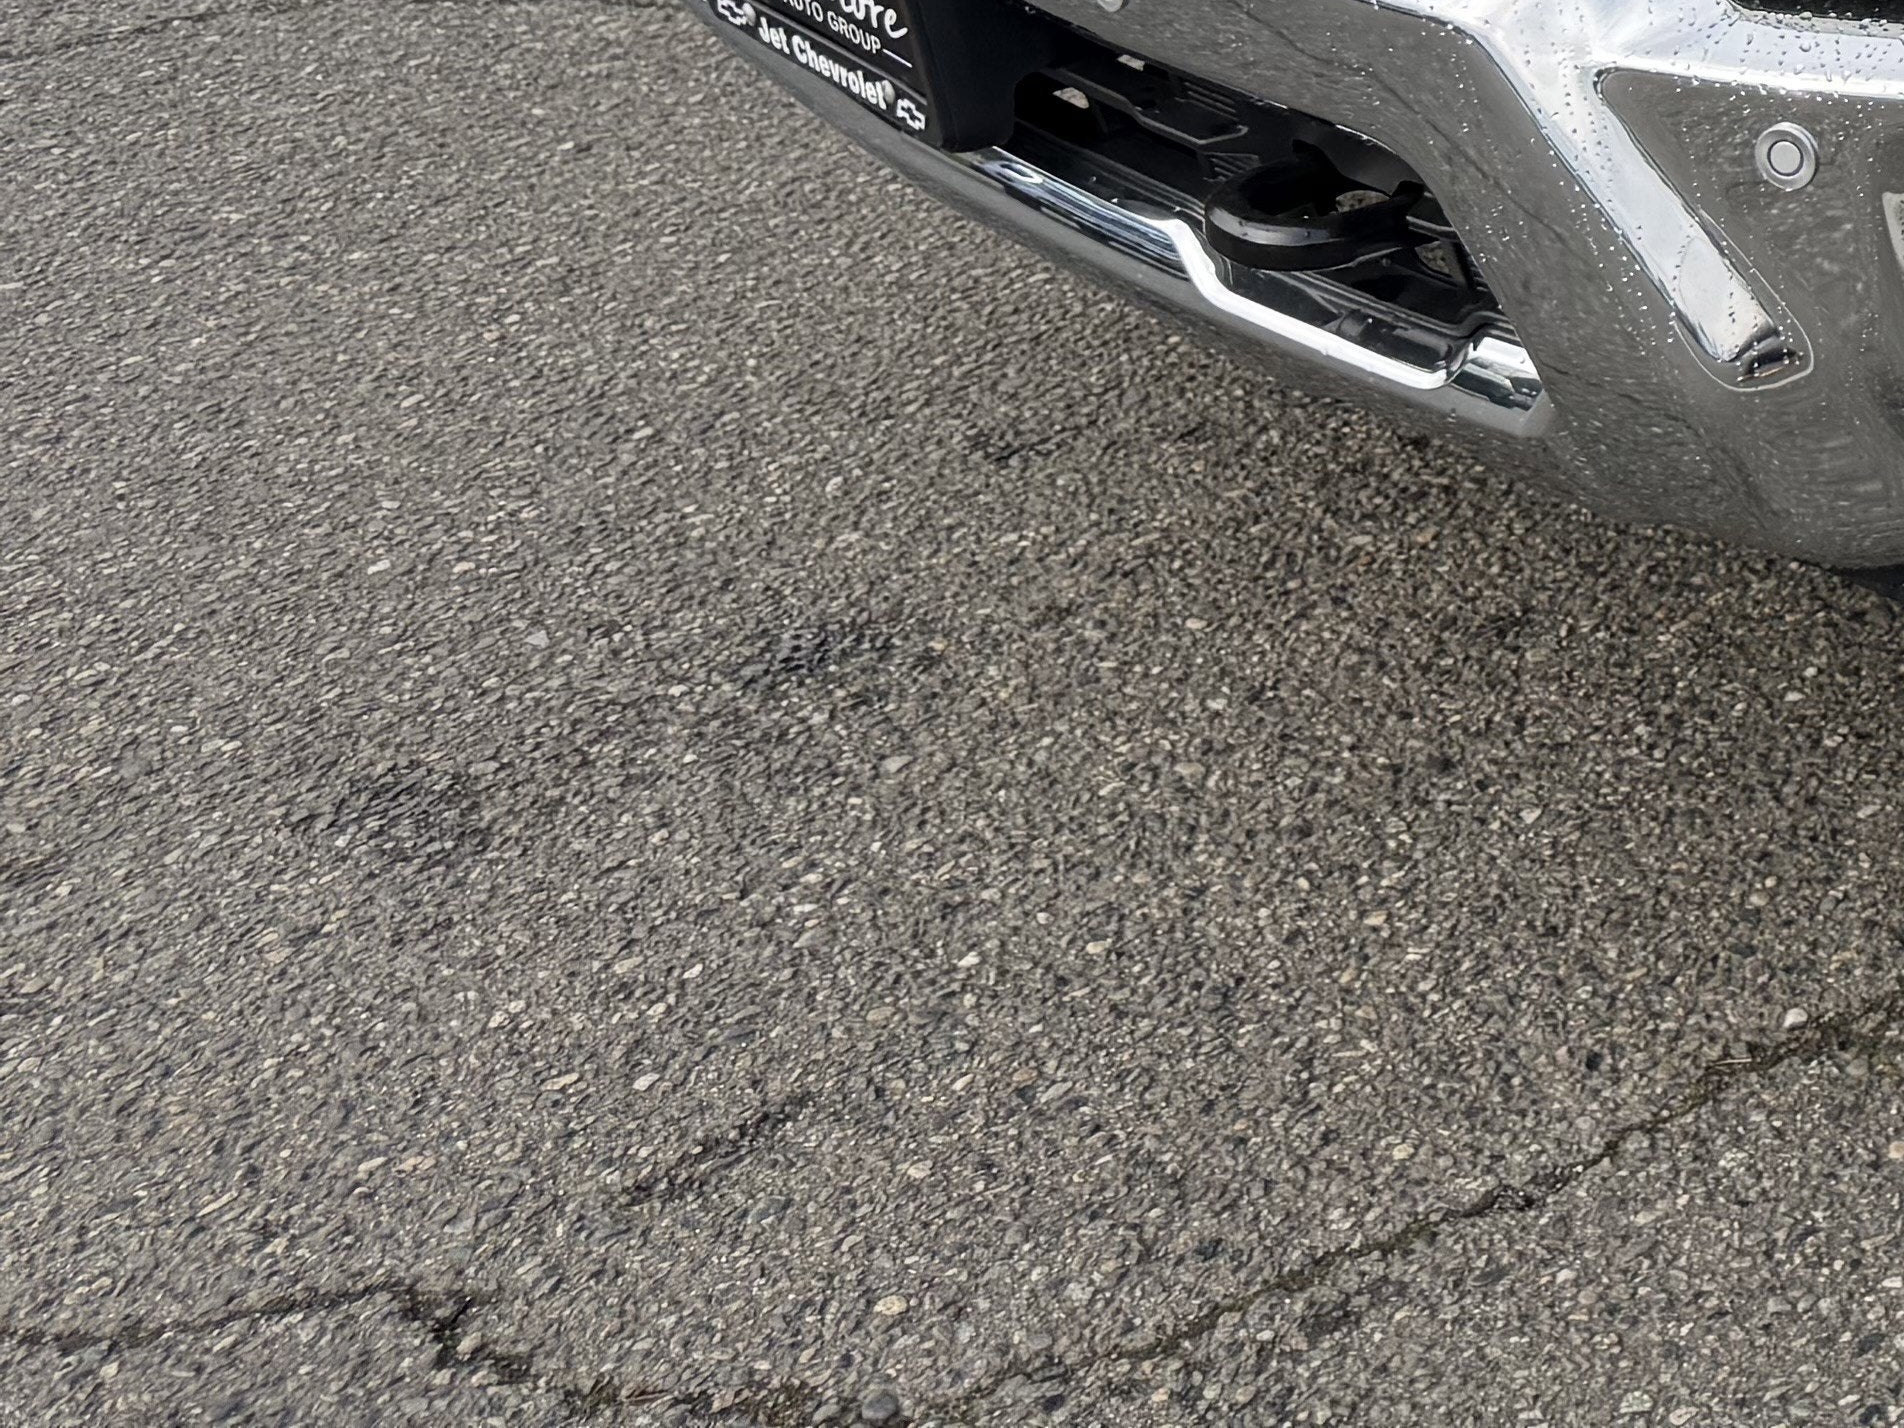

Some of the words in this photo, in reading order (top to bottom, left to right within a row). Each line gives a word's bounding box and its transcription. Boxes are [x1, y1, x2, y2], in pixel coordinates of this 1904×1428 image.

[758, 16, 791, 55] Jet
[791, 34, 887, 111] Chevrolet
[827, 10, 882, 54] GROUP
